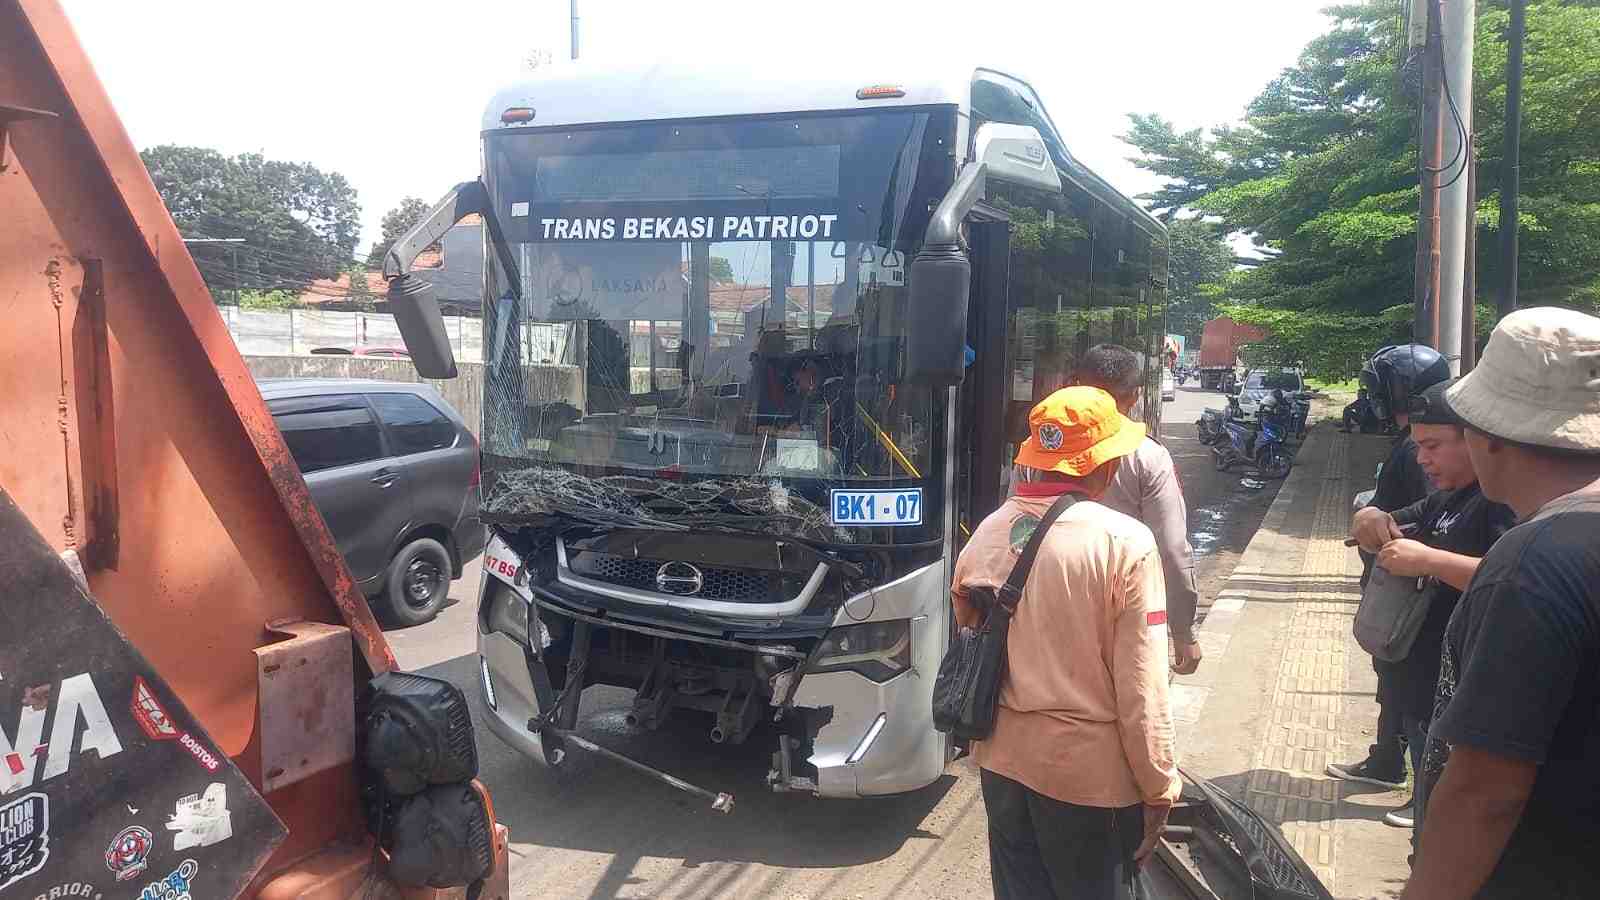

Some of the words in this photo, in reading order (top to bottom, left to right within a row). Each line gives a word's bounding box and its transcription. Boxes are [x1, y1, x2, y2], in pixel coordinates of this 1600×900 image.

[541, 218, 615, 239] TRANS
[623, 217, 714, 239] BEKASI
[722, 214, 838, 238] PATRIOT
[837, 494, 875, 520] BK1
[895, 493, 919, 520] 07
[498, 560, 519, 578] BS
